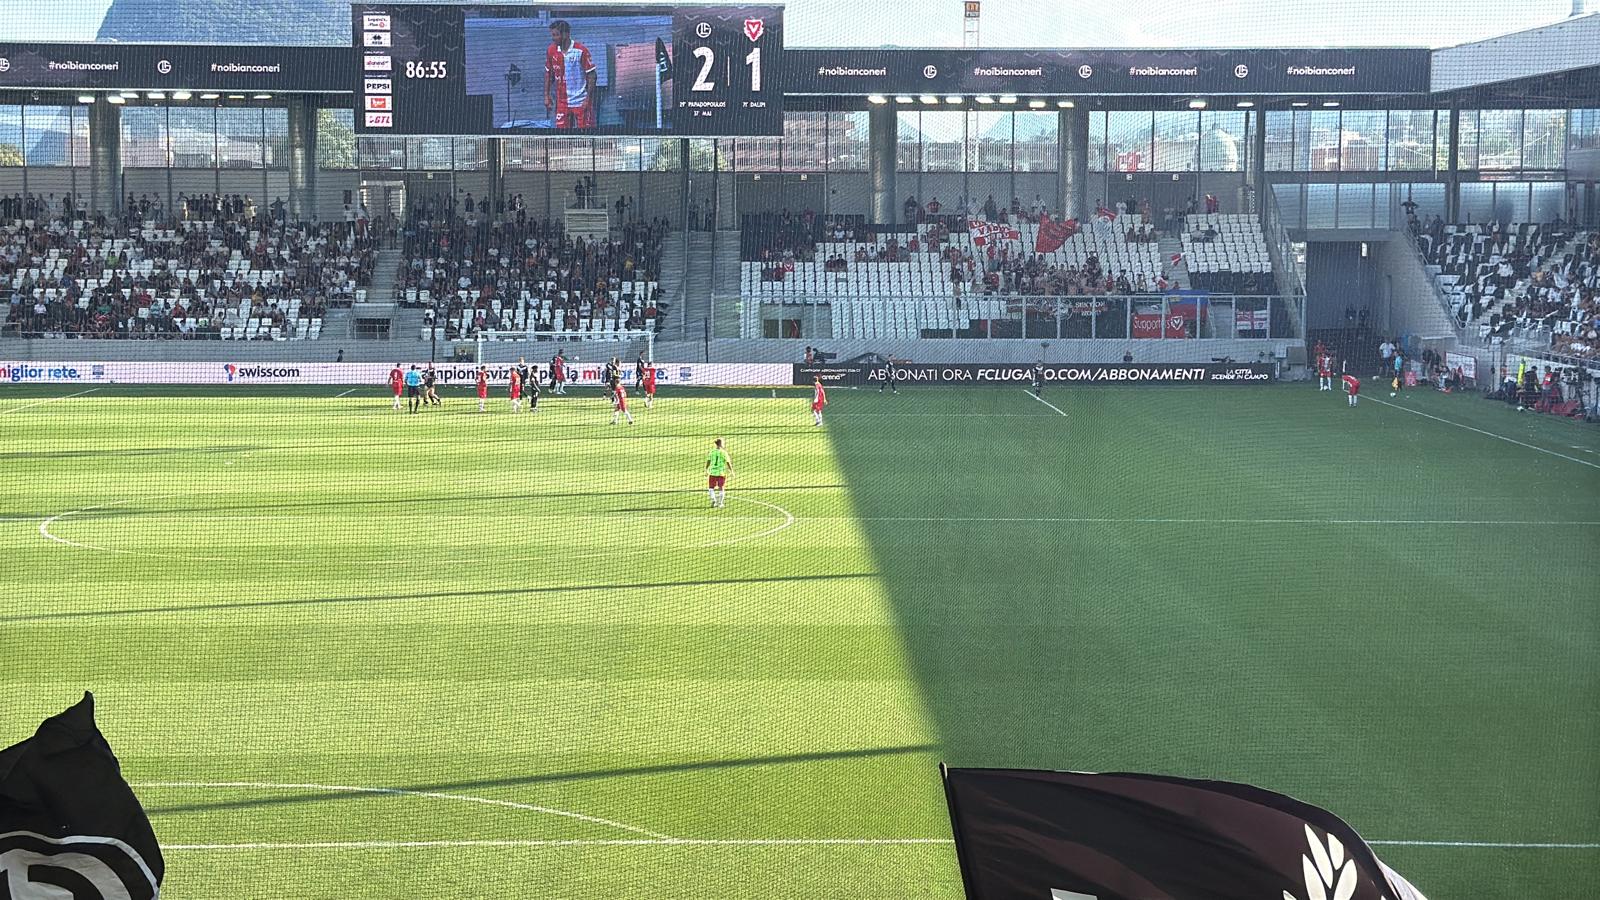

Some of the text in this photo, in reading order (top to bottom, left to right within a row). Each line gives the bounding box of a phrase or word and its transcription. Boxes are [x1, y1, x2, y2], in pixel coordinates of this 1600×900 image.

[49, 60, 119, 71] #noibianconeri
[211, 63, 280, 73] #noibianconeri
[405, 61, 447, 79] 86:55
[691, 46, 715, 91] 2
[745, 47, 761, 91] 1
[818, 66, 886, 76] #noibianconeri
[974, 67, 1042, 76] #noibianconeri
[1129, 66, 1197, 76] #noibianconeri
[1287, 66, 1355, 76] #noibianconeri
[48, 365, 81, 379] rete.
[239, 365, 300, 378] swisscom
[942, 368, 973, 381] ORA
[976, 367, 1206, 382] FCLUGAO.COM/ABBONAMENTI
